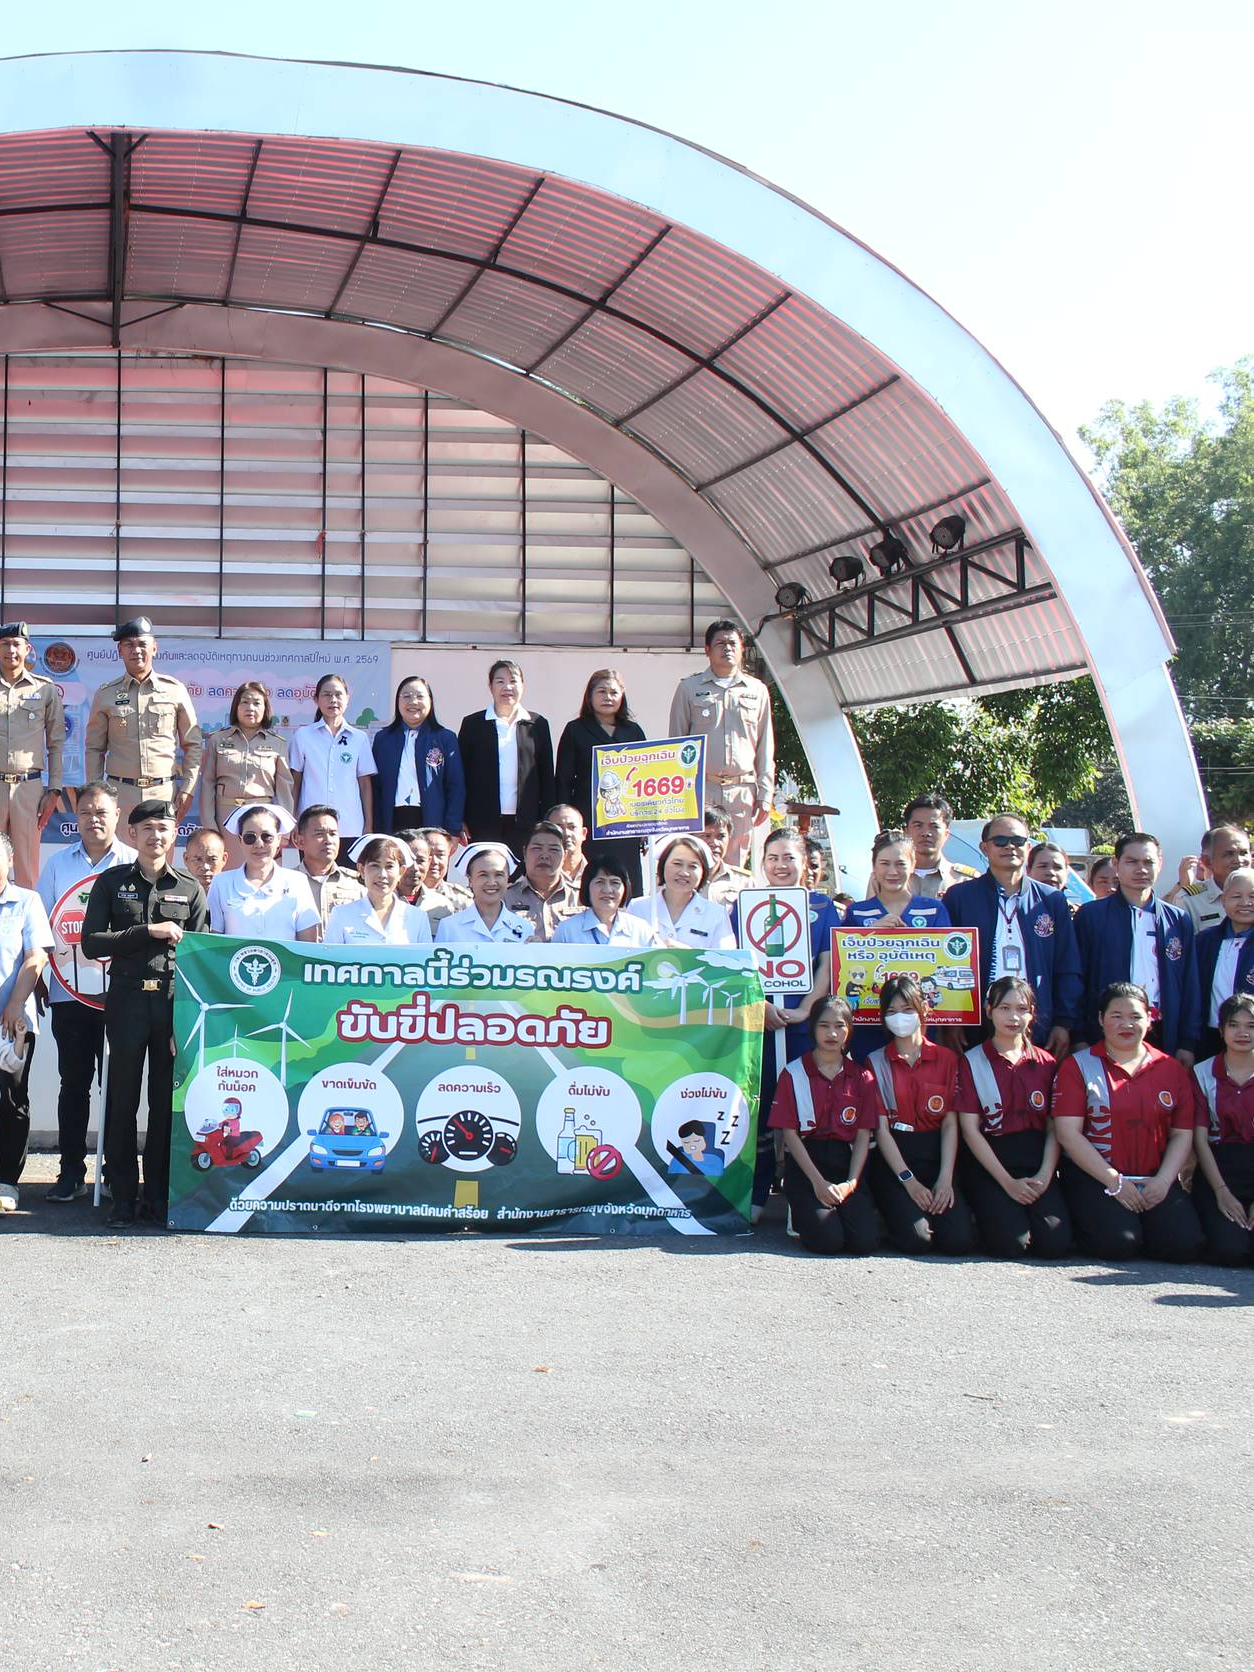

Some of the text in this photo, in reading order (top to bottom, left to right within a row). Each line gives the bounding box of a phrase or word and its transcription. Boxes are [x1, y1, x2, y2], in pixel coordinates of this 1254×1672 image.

[356, 655, 379, 664] 2569
[601, 751, 676, 766] เจ็บป่วยฉุกเฉิน
[632, 775, 685, 798] 1669
[842, 935, 940, 949] เจ็บป่วยฉุกเฉิน
[848, 949, 936, 962] หรือ อุบัติเหตุ
[304, 950, 642, 991] เทศกาลนี้ร่วมรณรงค์
[339, 994, 608, 1045] ขับขี่ปลอดภัย
[216, 1066, 259, 1079] ใส่หมวก
[218, 1080, 256, 1092] กันน็อค
[438, 1082, 501, 1094] ลดความเร็ว
[568, 1081, 610, 1097] ดื่มไม่ขับ
[680, 1087, 727, 1099] ง่วงไม่ขับ
